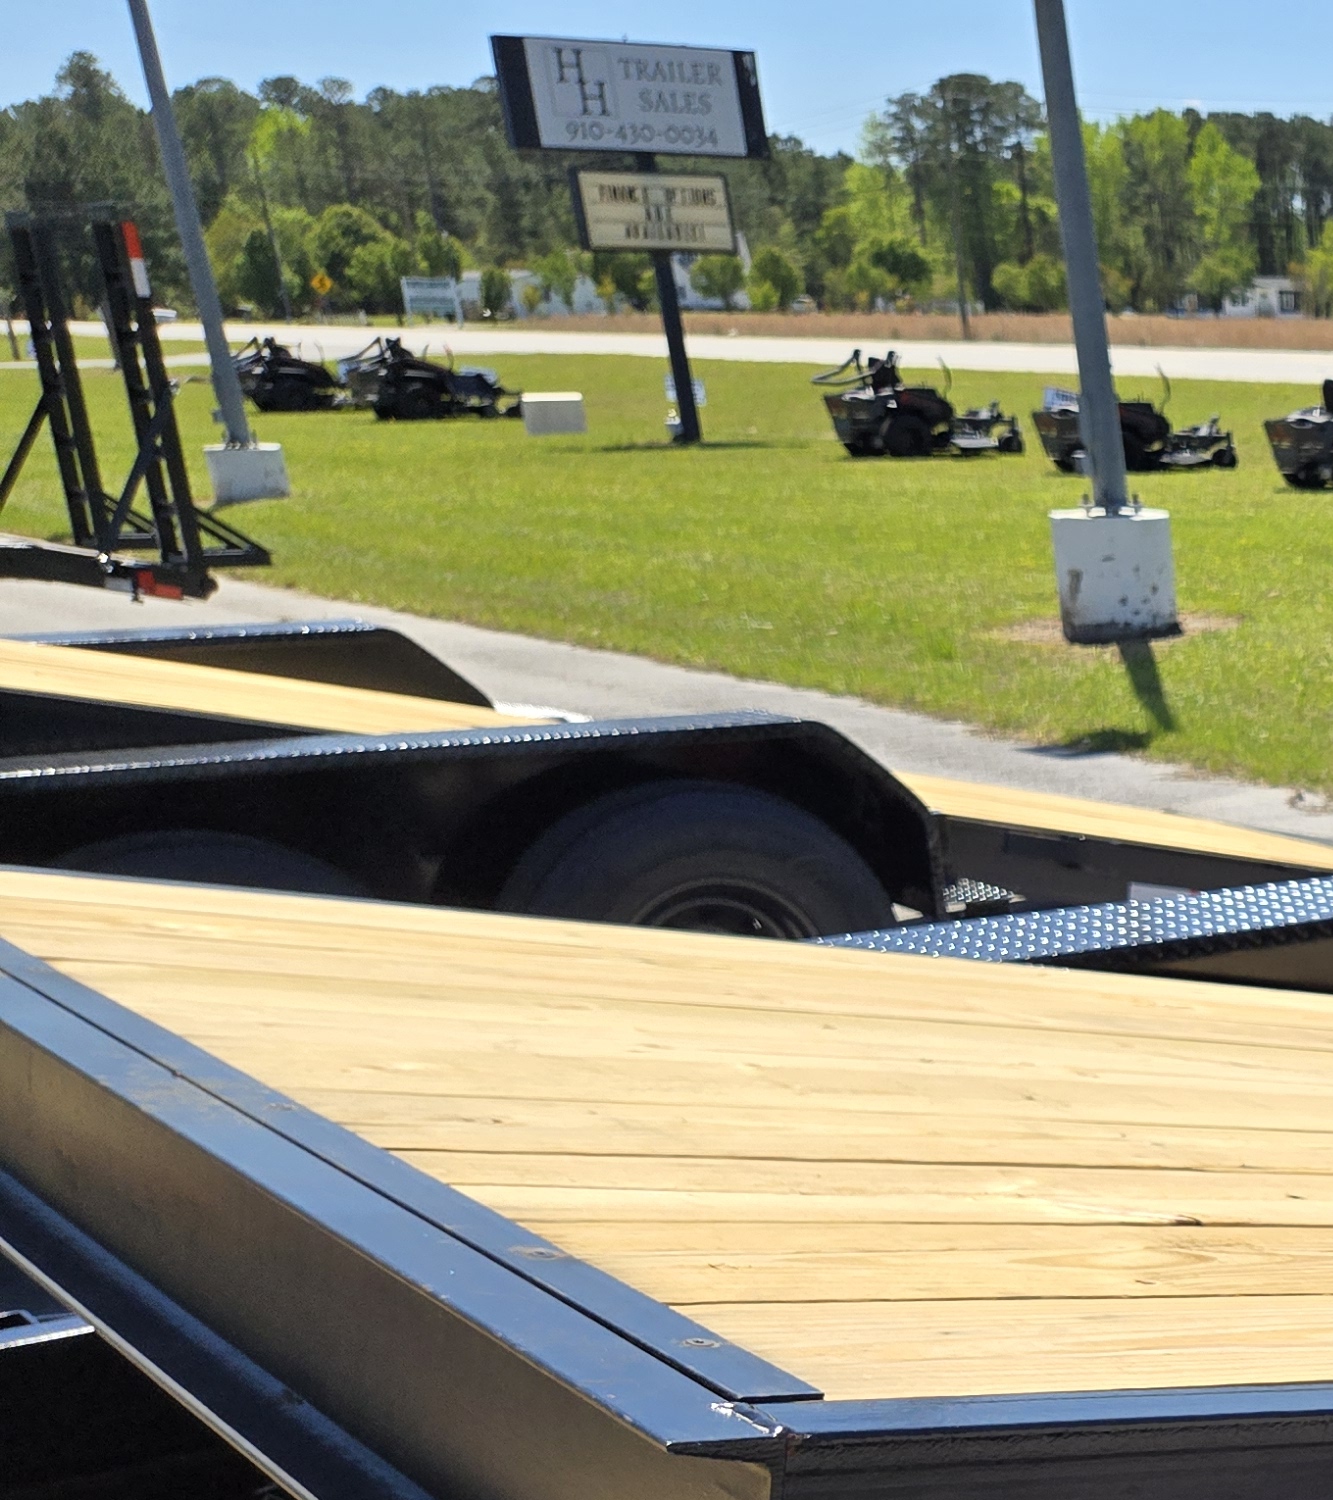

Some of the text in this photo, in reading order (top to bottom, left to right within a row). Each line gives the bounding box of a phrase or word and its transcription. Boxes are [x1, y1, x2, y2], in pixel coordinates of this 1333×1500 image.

[617, 57, 723, 87] TRAILER
[638, 88, 713, 116] SALES
[565, 120, 719, 149] 910-430-0034
